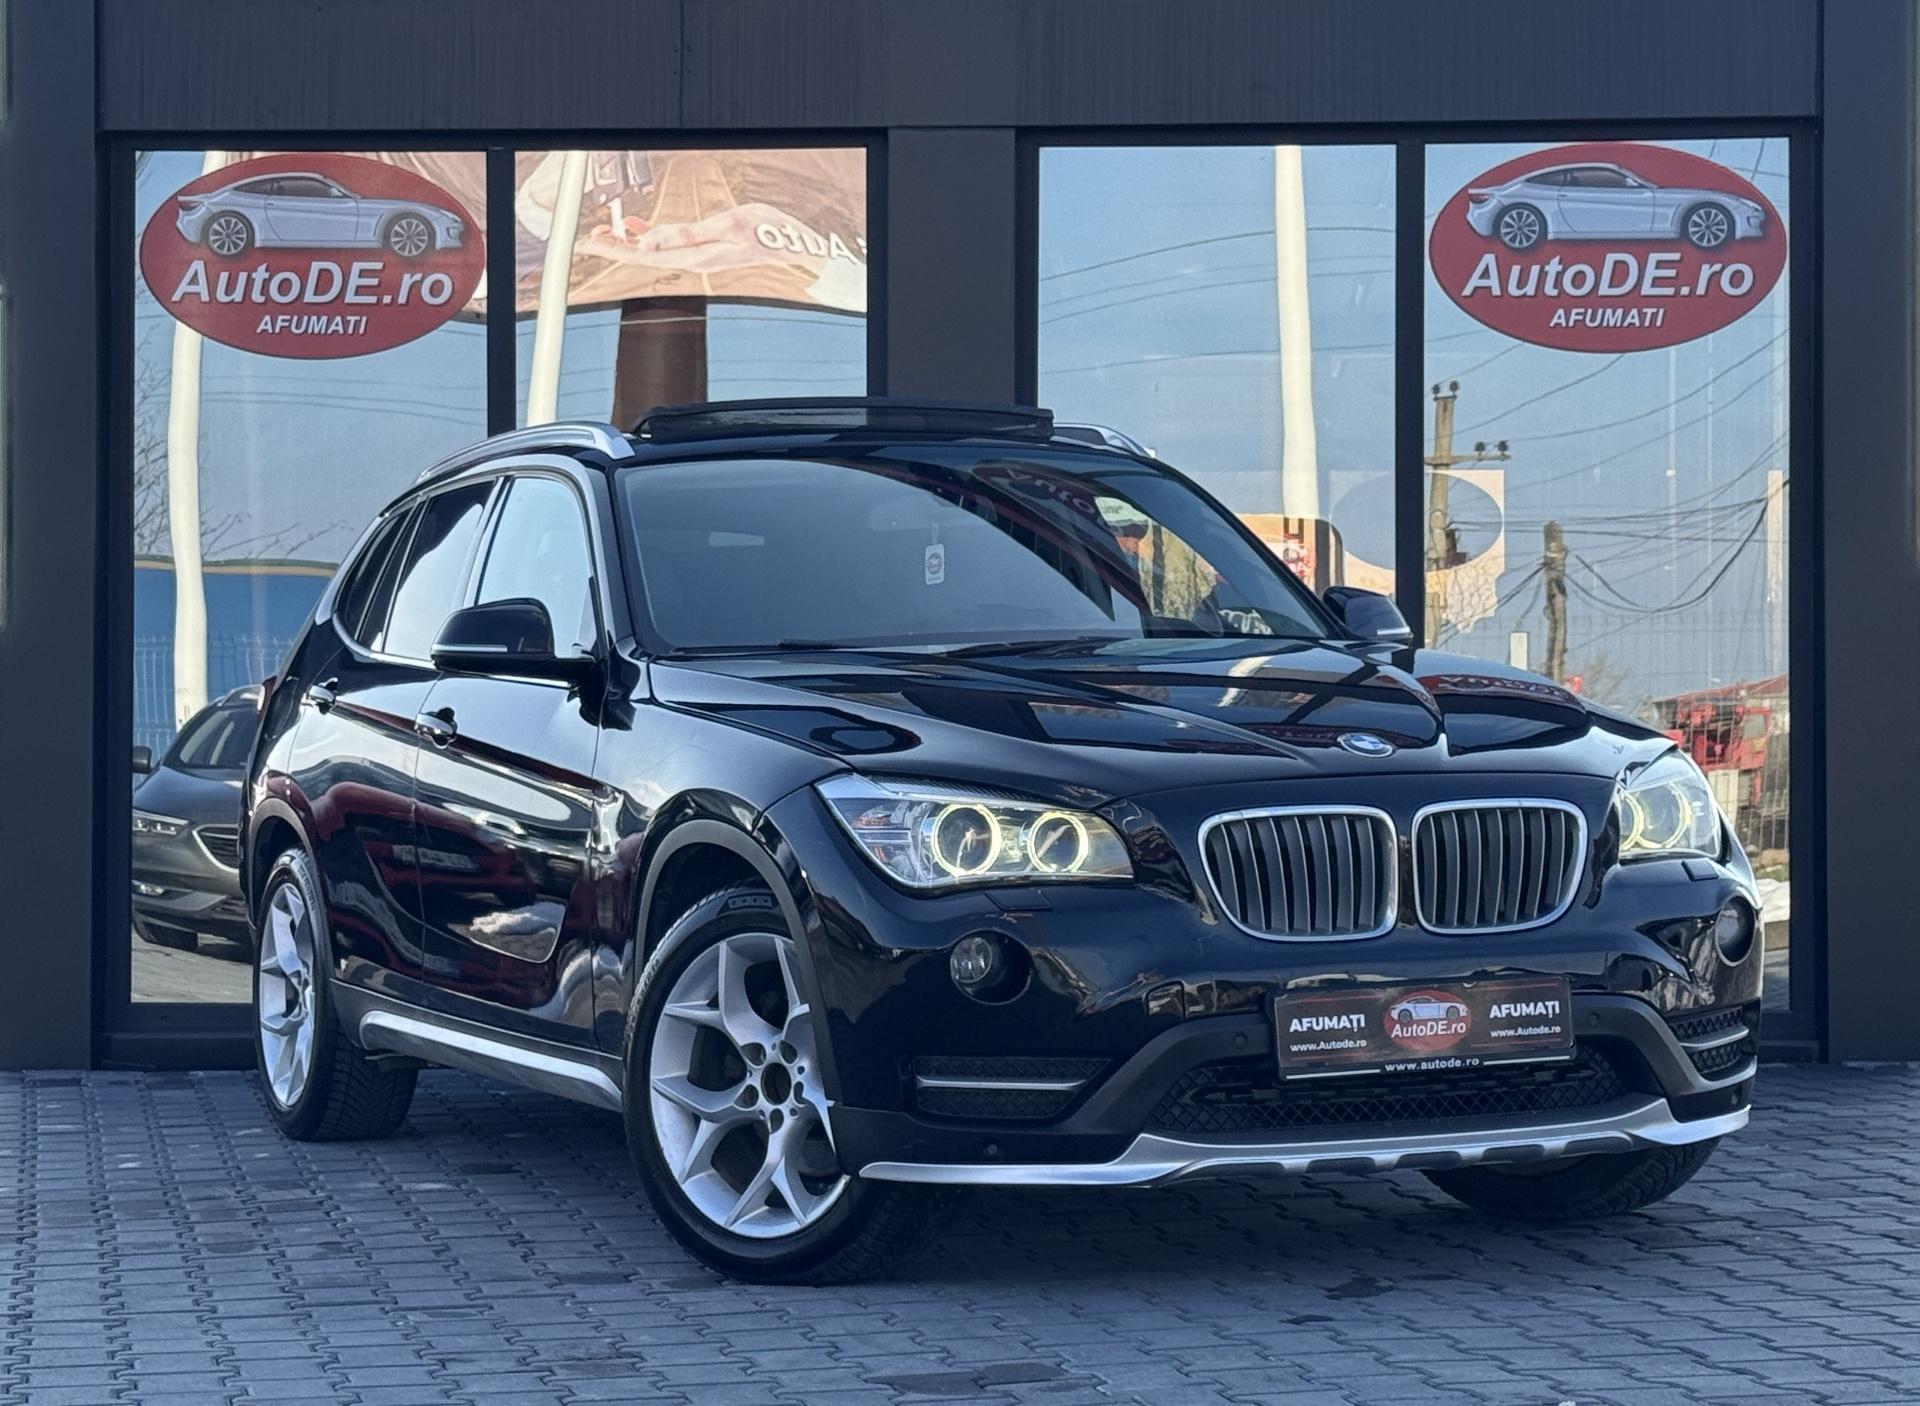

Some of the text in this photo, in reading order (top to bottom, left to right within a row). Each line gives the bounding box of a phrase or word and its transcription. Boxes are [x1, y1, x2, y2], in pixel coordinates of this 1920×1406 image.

[171, 259, 455, 306] AutoDE.ro
[1460, 252, 1755, 298] AutoDE.ro
[256, 315, 368, 336] AFUMATI
[1549, 308, 1666, 329] AFUMATI
[1391, 1020, 1467, 1039] AutoDE.ro
[1489, 1024, 1562, 1038] www.Autode.ro
[1289, 1039, 1368, 1052] www.Autode.ro
[1384, 1057, 1480, 1072] www.autode.ro
